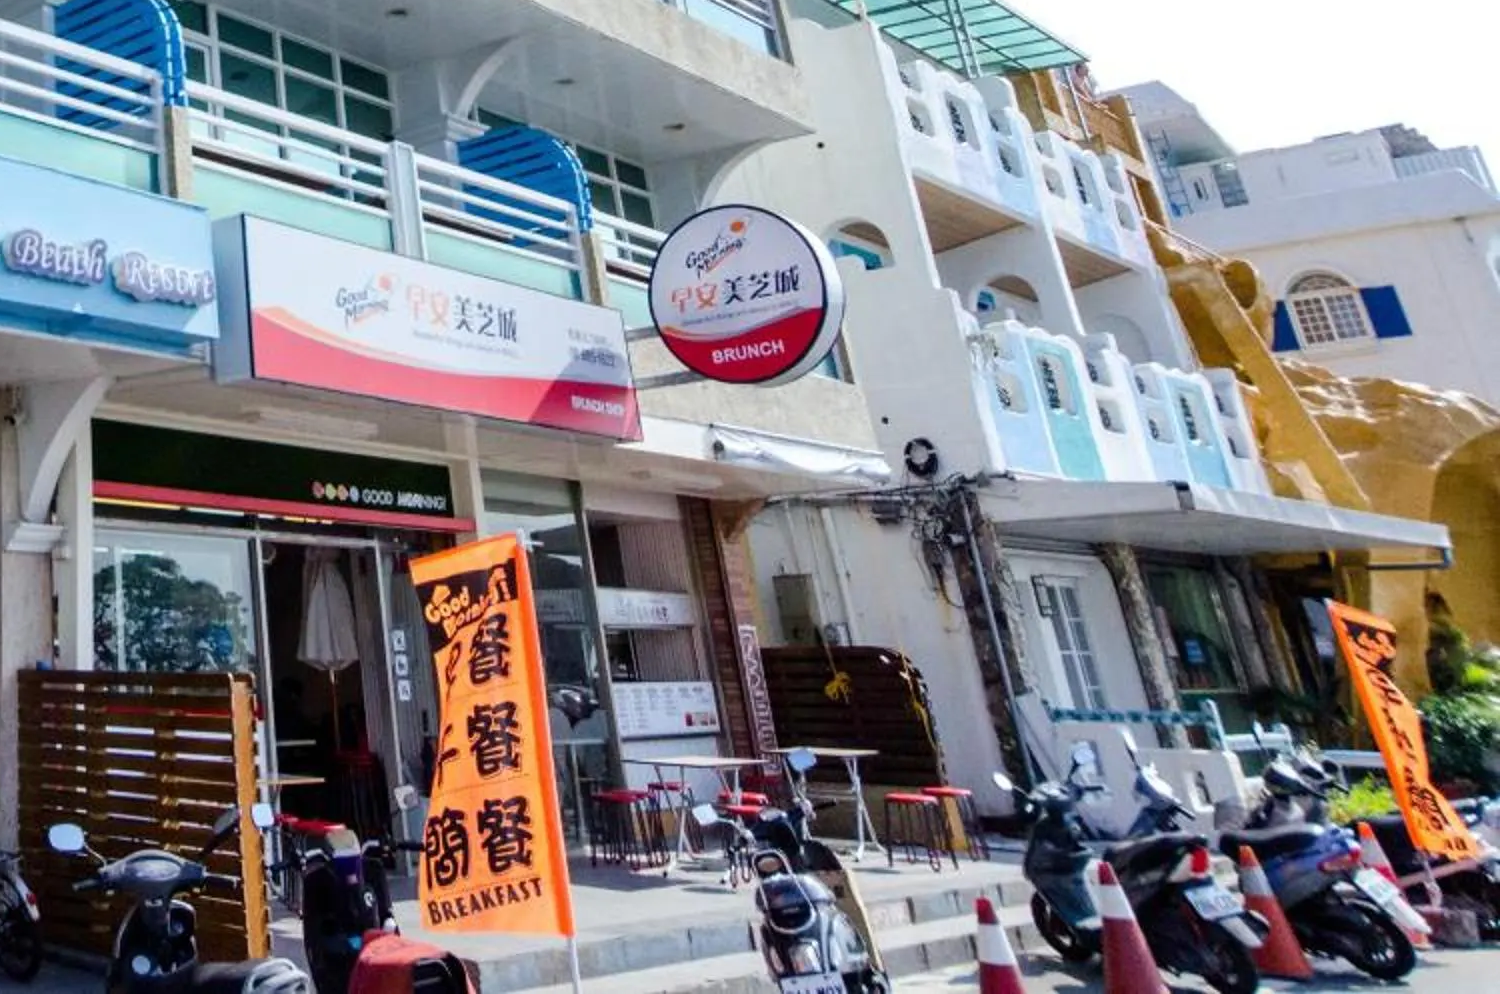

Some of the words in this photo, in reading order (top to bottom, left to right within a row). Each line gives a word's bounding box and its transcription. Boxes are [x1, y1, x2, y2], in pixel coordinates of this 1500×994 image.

[10, 230, 108, 284] Beach
[122, 253, 214, 302] Resort
[684, 233, 723, 270] Good
[405, 284, 518, 344] 早安美芝城
[670, 264, 801, 315] 早安美芝城
[711, 338, 786, 366] BRUNCH
[361, 487, 395, 506] GOOD
[424, 582, 471, 625] Good
[425, 794, 534, 893] 簡餐
[427, 877, 544, 927] BREAKFAST
